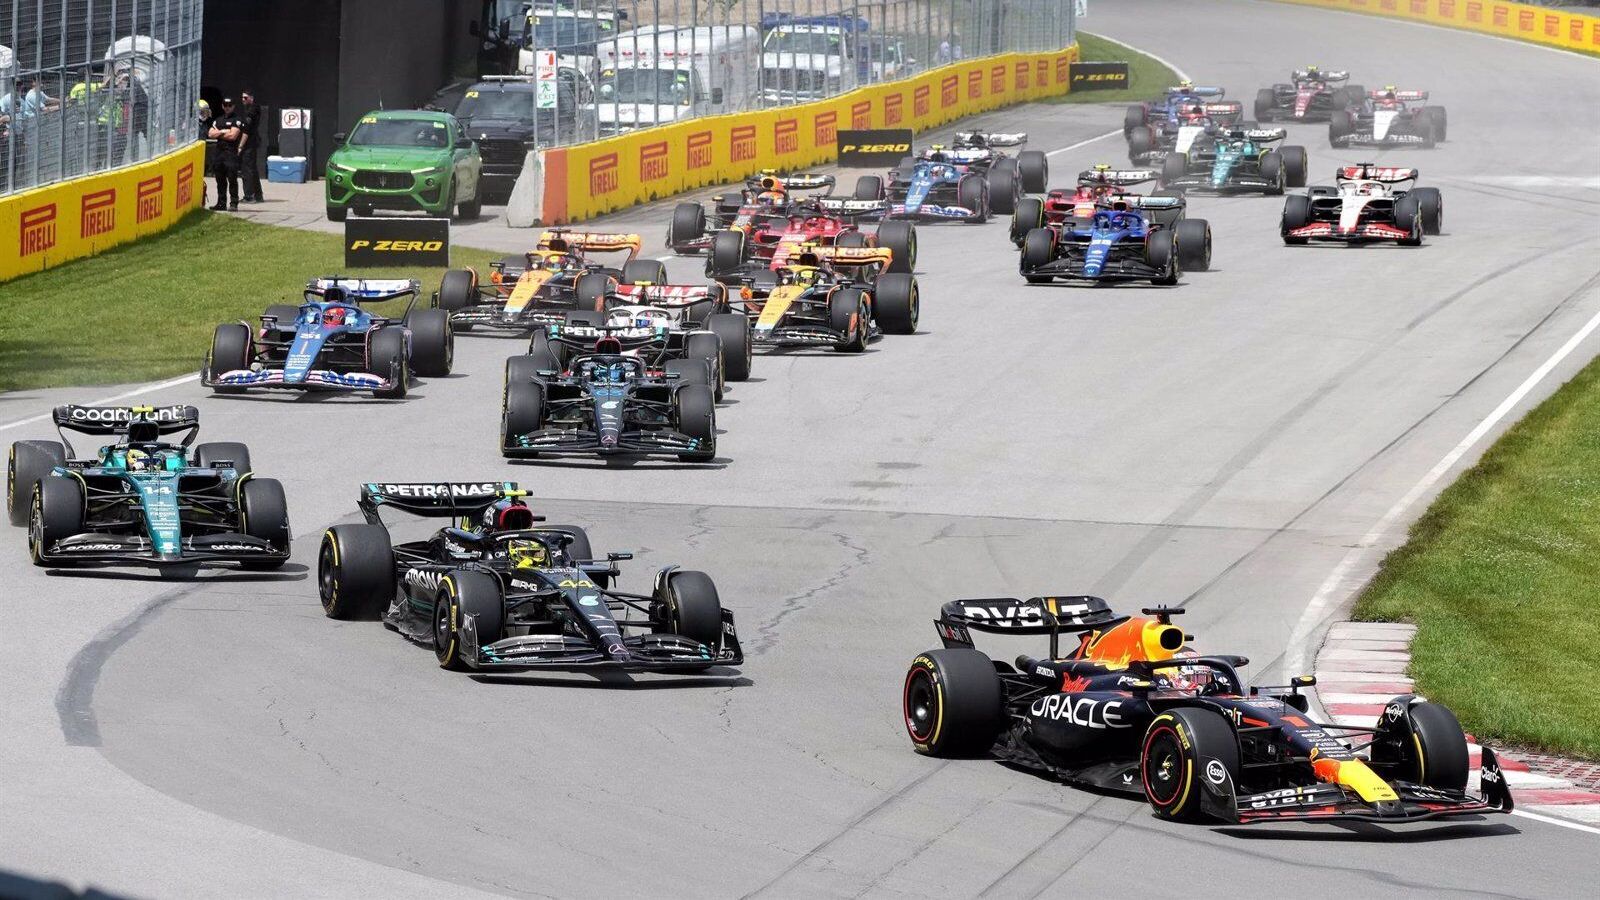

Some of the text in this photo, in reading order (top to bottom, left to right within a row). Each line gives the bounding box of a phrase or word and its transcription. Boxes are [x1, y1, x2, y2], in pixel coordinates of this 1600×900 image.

[687, 130, 712, 170] PIRELLI
[730, 125, 756, 163] PIRELLI
[775, 118, 798, 155] PIRELLI
[858, 144, 910, 153] ZERO
[590, 152, 618, 197] PIRELLI
[640, 141, 668, 183] PIRELLI
[137, 175, 164, 224] PIRELLI
[176, 162, 193, 209] PIRELLI
[20, 203, 56, 257] PIRELLI
[81, 188, 116, 239] PIRELLI
[351, 241, 443, 251] P ZERO
[1036, 666, 1056, 678] HONDA
[1031, 694, 1132, 729] ORACLE
[1210, 765, 1223, 778] Esso
[1481, 766, 1498, 783] Claro
